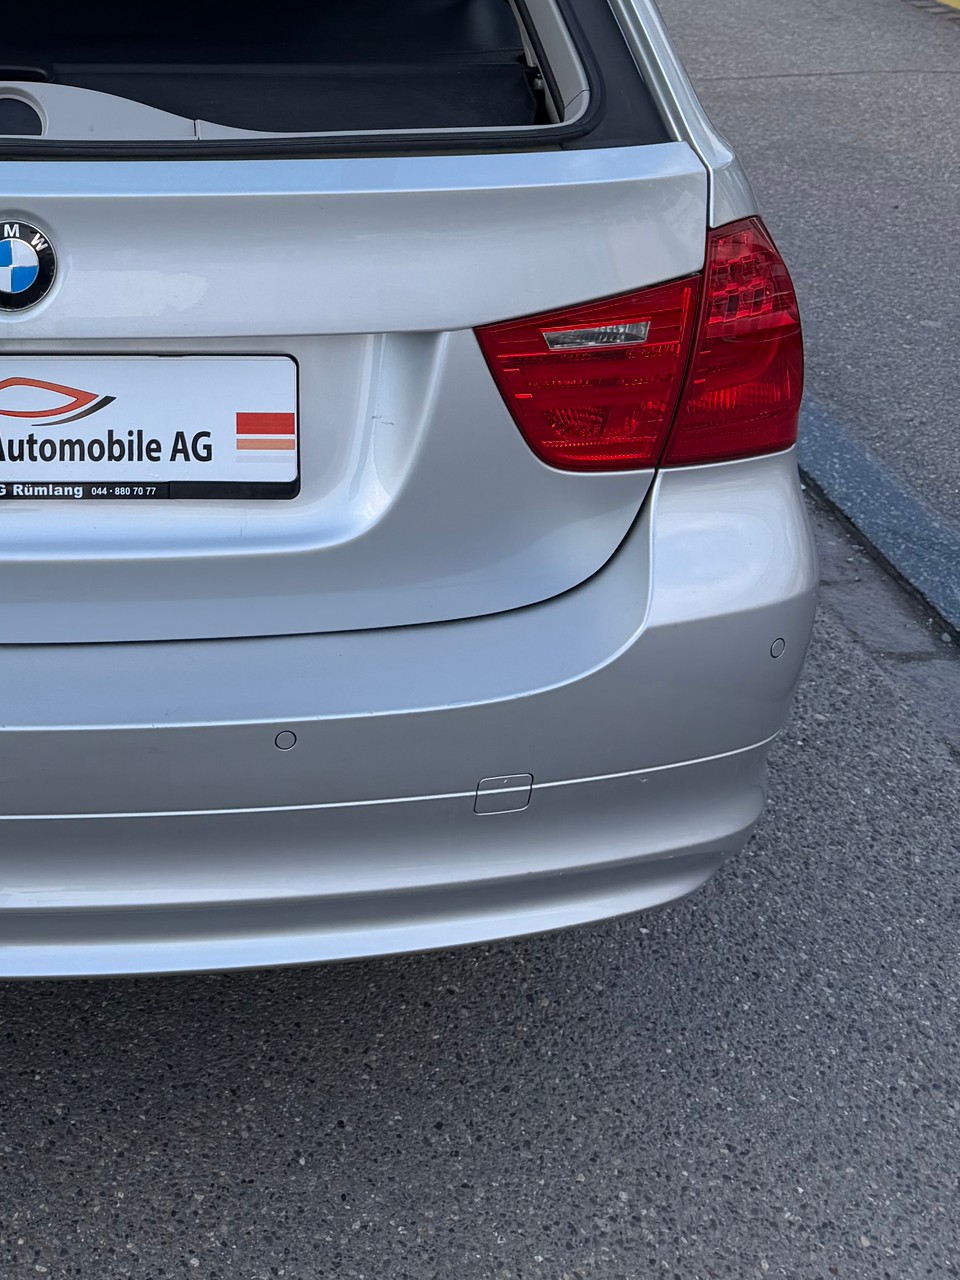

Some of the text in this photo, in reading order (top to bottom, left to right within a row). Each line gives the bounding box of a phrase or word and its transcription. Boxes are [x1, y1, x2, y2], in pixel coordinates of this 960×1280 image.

[169, 430, 213, 463] AG
[12, 484, 84, 498] Rümlang
[91, 487, 108, 496] 044
[114, 487, 131, 496] 880
[133, 487, 144, 496] 70
[146, 487, 157, 496] 77
